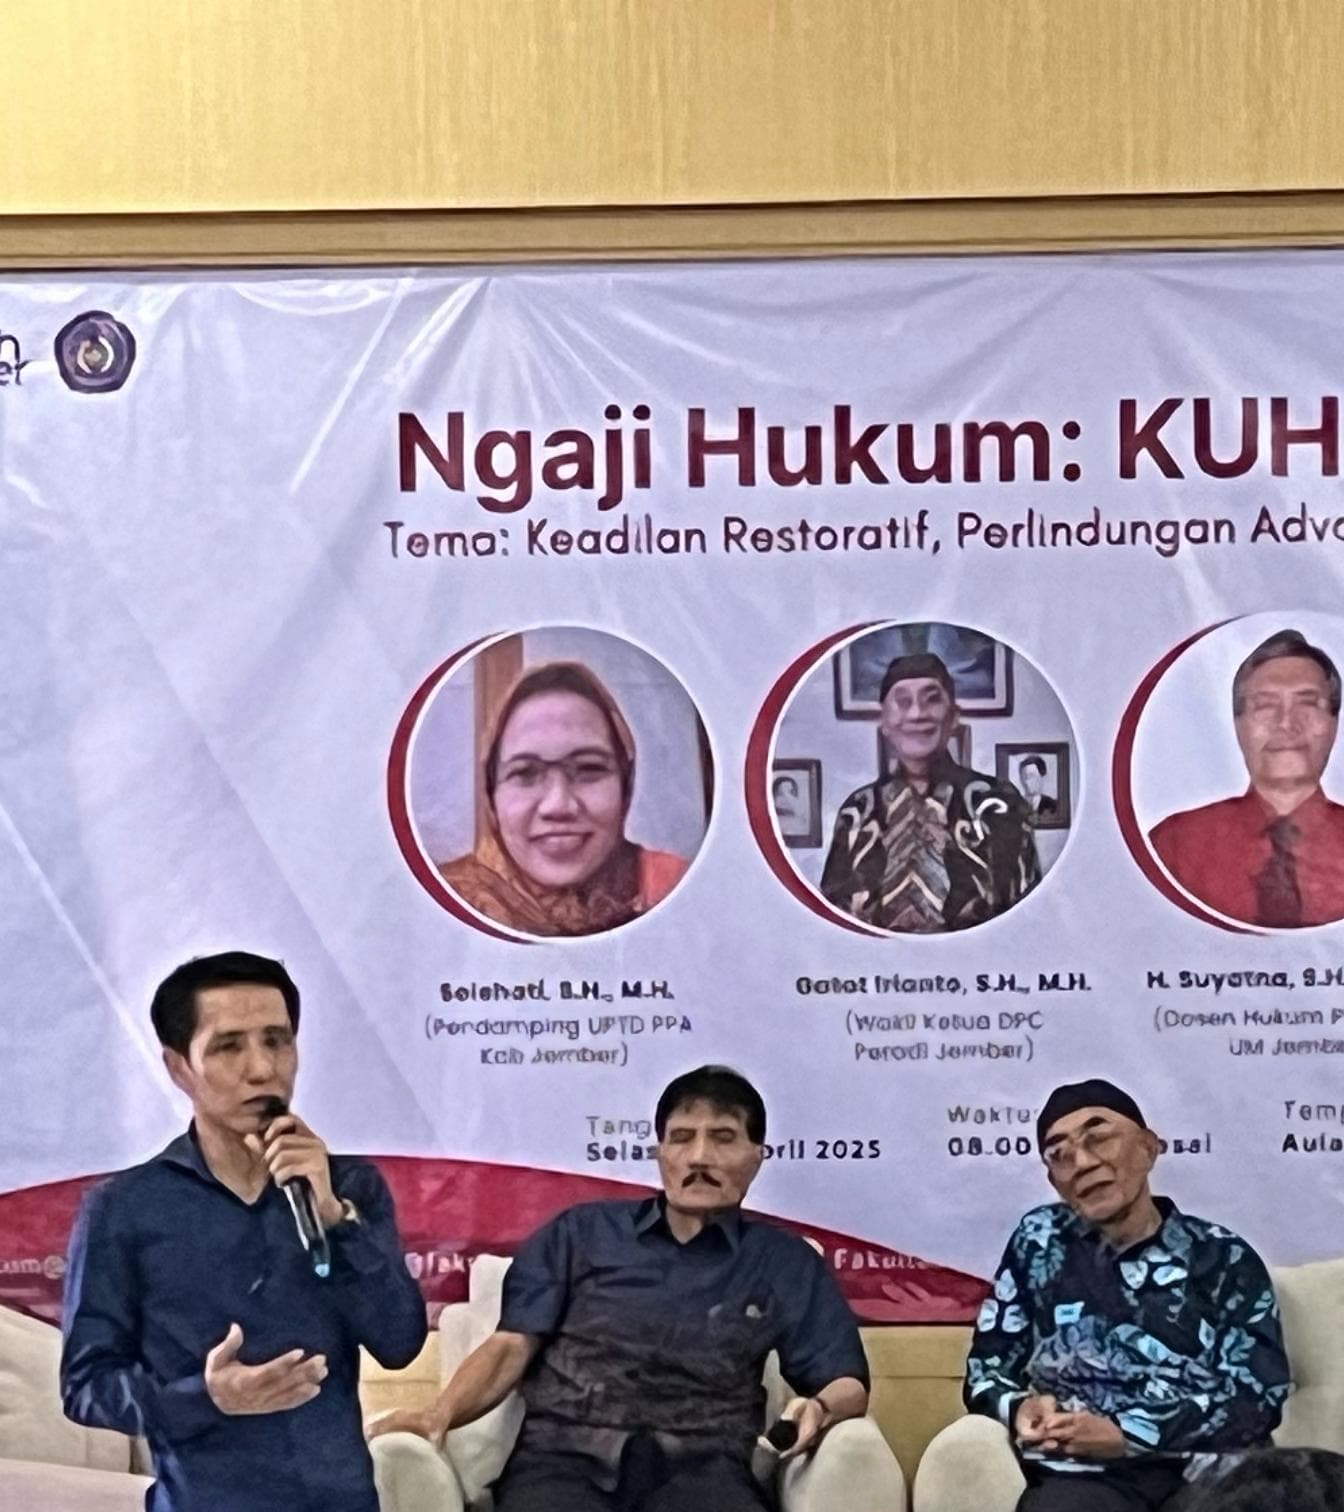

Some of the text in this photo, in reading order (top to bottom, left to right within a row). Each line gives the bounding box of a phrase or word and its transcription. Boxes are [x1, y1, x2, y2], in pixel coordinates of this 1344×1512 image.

[398, 404, 652, 513] Ngaji
[687, 405, 1083, 487] Hukum:
[383, 519, 510, 558] Tema:
[527, 514, 707, 556] Keadilan
[724, 511, 942, 556] Restoratif,
[958, 507, 1236, 557] Perlindungan
[652, 1015, 692, 1033] PPA
[586, 1115, 652, 1140] Tang
[586, 1142, 659, 1162] Selas
[815, 1139, 881, 1159] 2025
[1282, 1134, 1344, 1152] Aula
